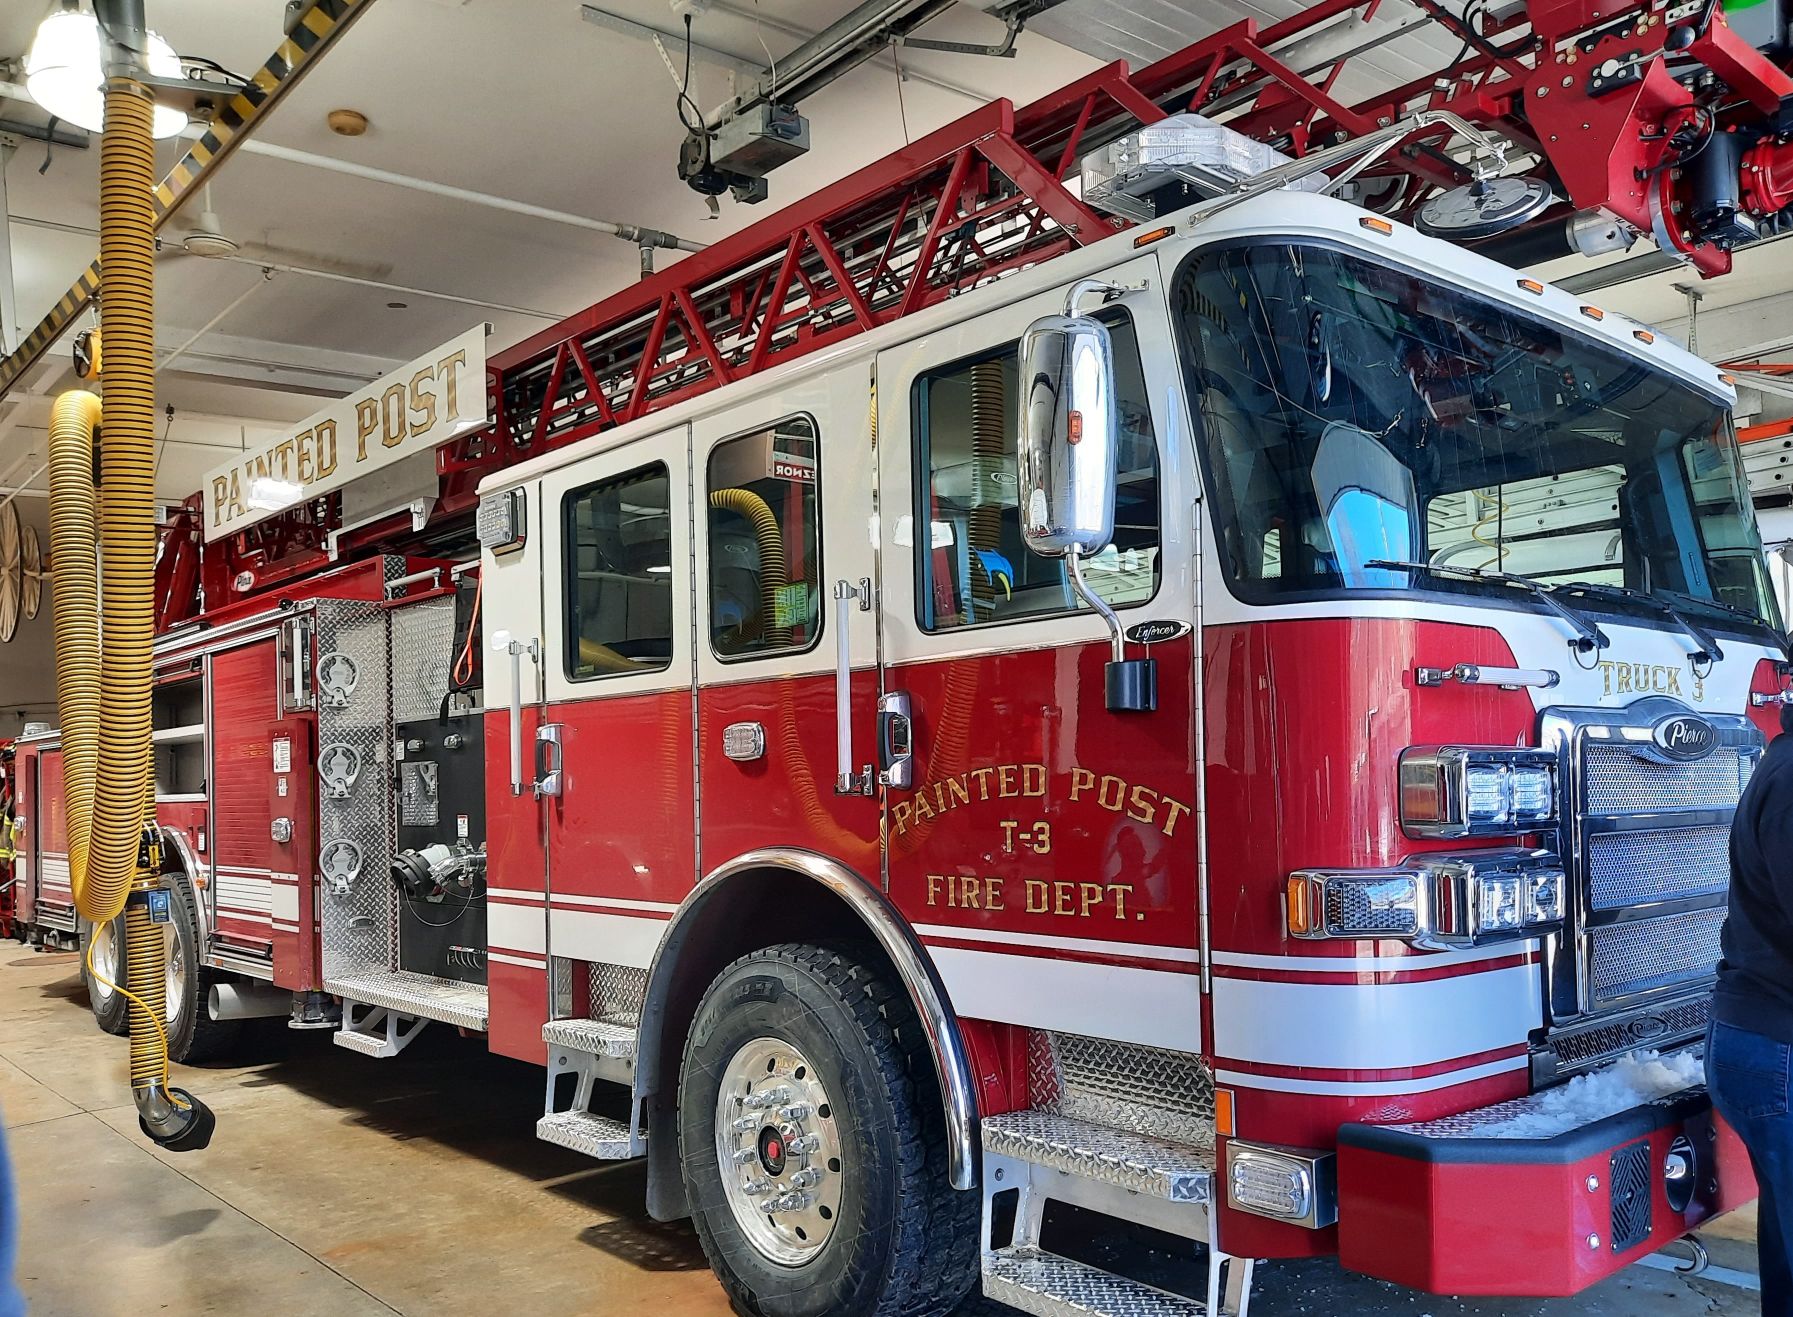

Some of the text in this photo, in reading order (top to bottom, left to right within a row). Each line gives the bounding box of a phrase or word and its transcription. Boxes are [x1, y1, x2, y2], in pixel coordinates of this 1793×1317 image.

[355, 348, 466, 463] POST
[1135, 625, 1175, 641] Enforcer
[1598, 660, 1704, 702] TRUCK 3
[1671, 721, 1708, 747] Pierce
[891, 764, 1191, 837] PAINTED POST
[1000, 821, 1051, 854] T-3
[926, 874, 1145, 921] FIRE DEPT.
